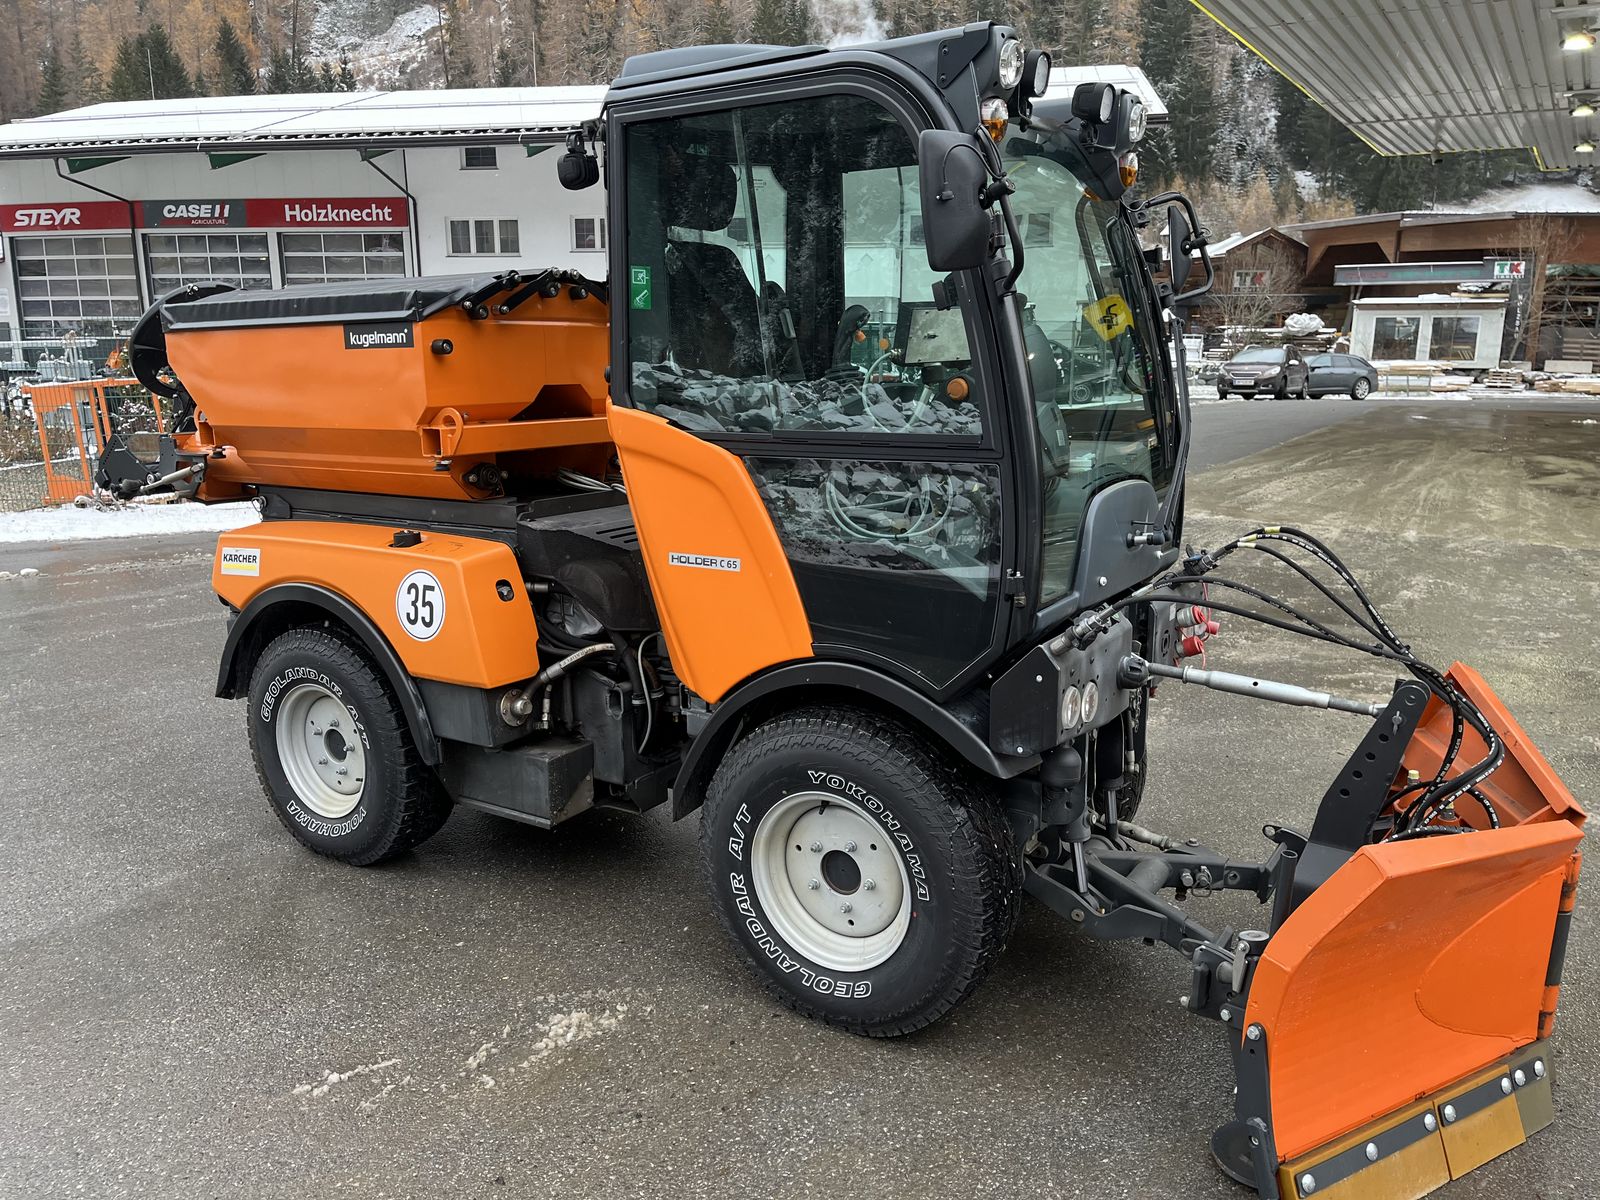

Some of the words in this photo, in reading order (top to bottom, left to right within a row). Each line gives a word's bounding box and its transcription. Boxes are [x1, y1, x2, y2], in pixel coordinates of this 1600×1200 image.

[13, 207, 81, 227] STEYR
[162, 204, 212, 218] CASE
[284, 203, 393, 222] Holzknecht
[349, 330, 407, 347] kugelmann
[671, 554, 718, 567] HOLDER
[719, 559, 725, 568] C
[726, 560, 738, 569] 65
[405, 582, 435, 629] 35
[261, 667, 343, 723] GEOLANDAR
[346, 705, 371, 750] A/T
[286, 799, 367, 838] YOKOHAMA
[727, 803, 754, 861] A/T
[807, 770, 930, 902] YOKOHAMA
[728, 871, 872, 999] GEOLANDAR
